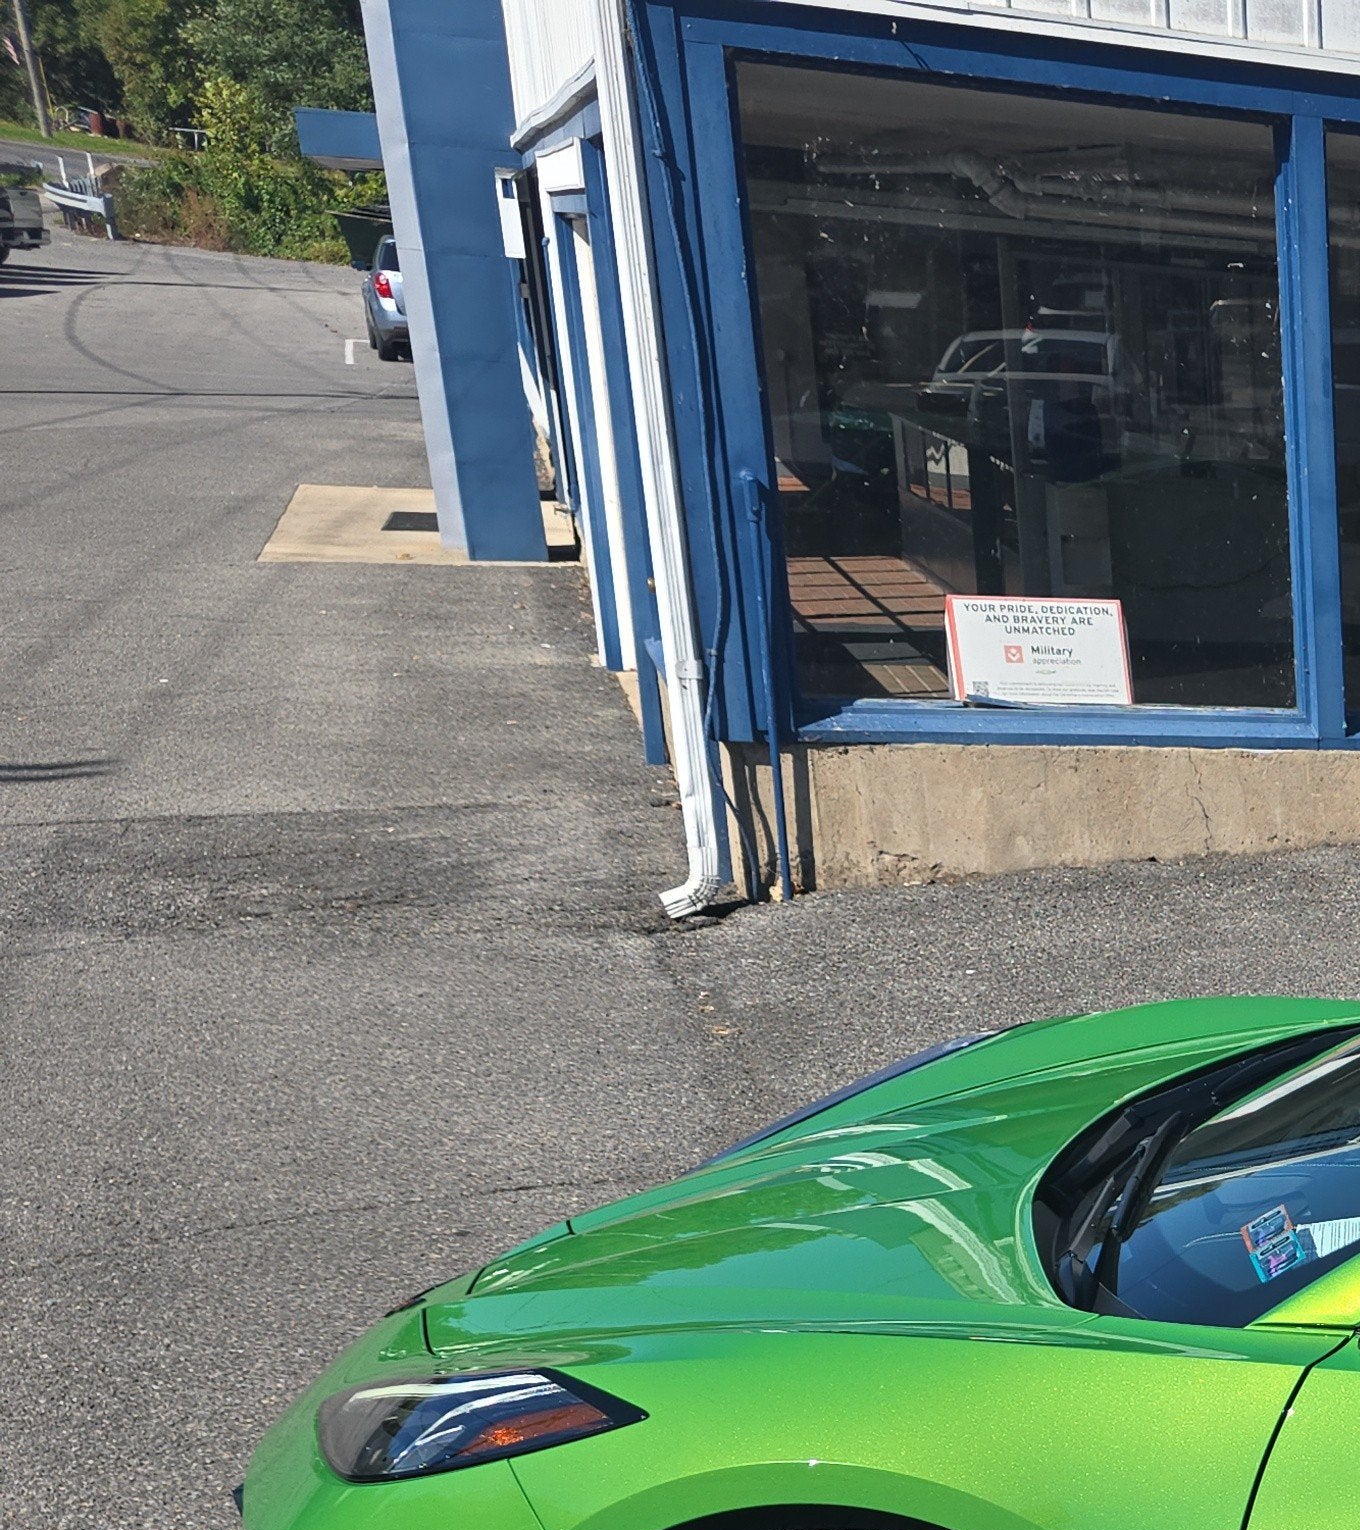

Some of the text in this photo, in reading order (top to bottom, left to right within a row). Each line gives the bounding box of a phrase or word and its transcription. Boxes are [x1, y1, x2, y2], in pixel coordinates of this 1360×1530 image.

[963, 603, 1114, 617] YOUR PRIDE, DEDICATION,
[984, 614, 1094, 626] AND BRAVERY ARE
[1004, 625, 1076, 636] UNMATCHED
[1031, 645, 1074, 658] Military
